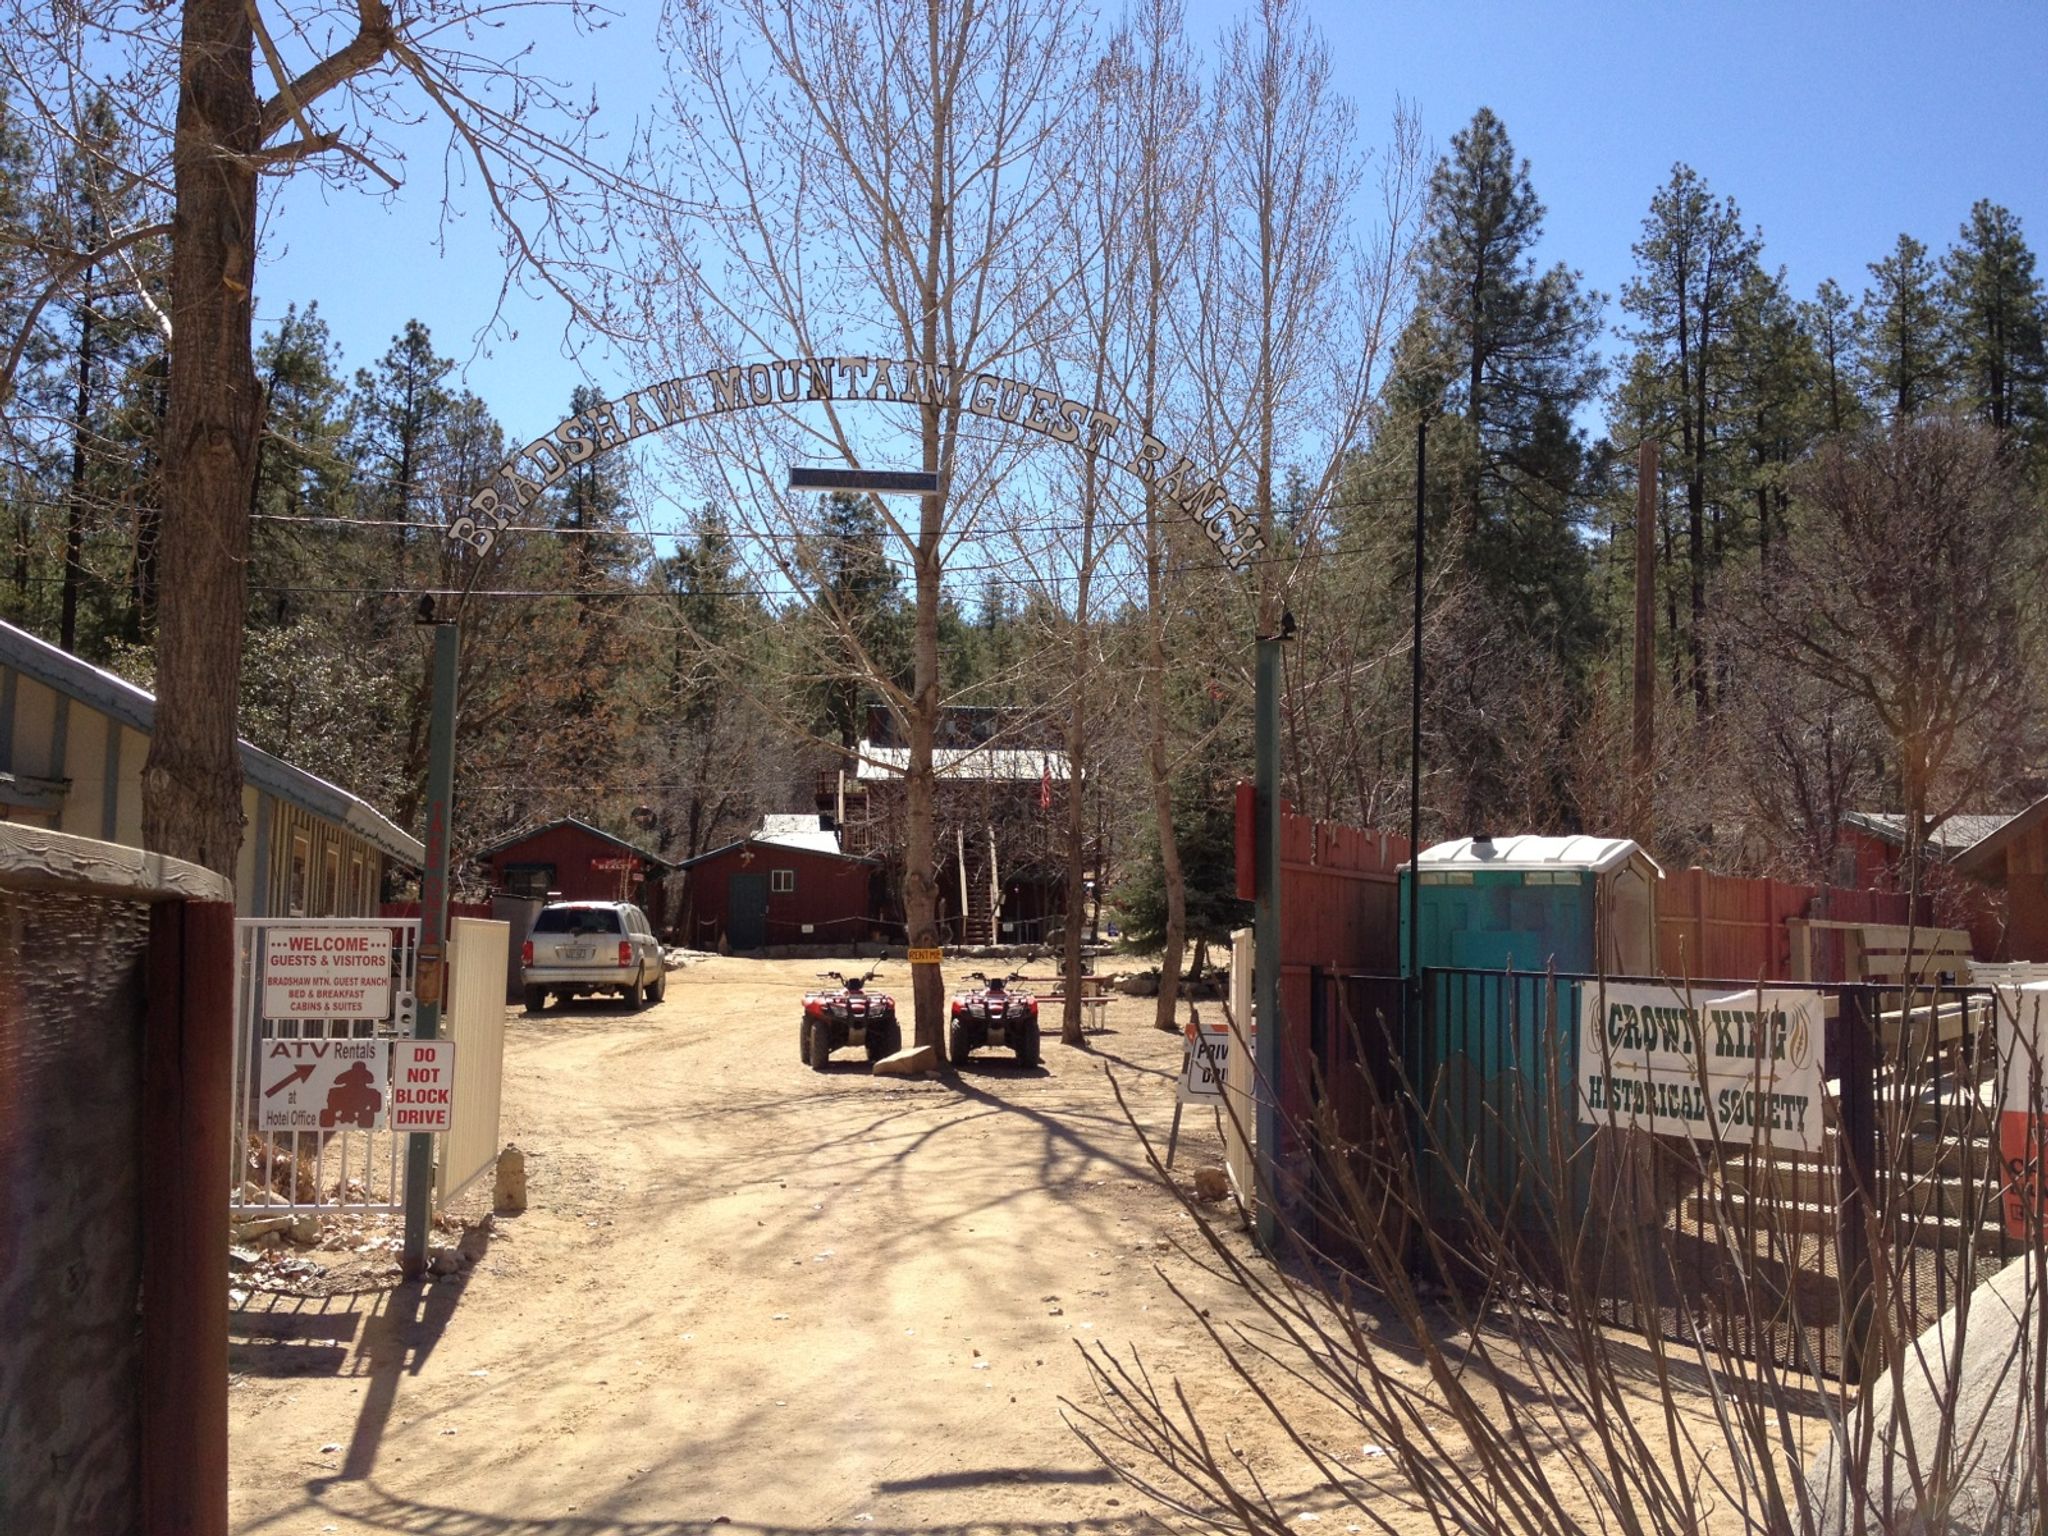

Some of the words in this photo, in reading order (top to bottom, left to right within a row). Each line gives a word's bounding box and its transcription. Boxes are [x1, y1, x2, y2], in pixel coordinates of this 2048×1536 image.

[447, 377, 686, 558] BRADSHAW
[707, 356, 951, 412] MOUNTAIN
[971, 374, 1120, 453] GUEST
[1126, 433, 1267, 570] RANCH
[289, 937, 369, 951] WELCOME
[271, 955, 317, 967] GUESTS
[321, 956, 329, 966] &
[333, 955, 386, 967] VISITORS
[267, 977, 310, 986] BRADSHAW
[312, 977, 331, 986] MTN.
[333, 977, 356, 987] GUEST
[361, 977, 388, 987] RANCH
[288, 990, 306, 999] BED
[308, 990, 314, 999] &
[316, 990, 365, 999] BREAKFAST
[290, 1002, 322, 1011] CABINS
[324, 1002, 330, 1011] &
[333, 1002, 363, 1011] SUITES
[1608, 1003, 1699, 1054] CROWN
[1711, 1010, 1787, 1060] KING
[270, 1042, 330, 1058] ATV
[334, 1042, 376, 1059] Rentals
[414, 1048, 436, 1062] DO
[407, 1068, 440, 1083] NOT
[288, 1090, 296, 1104] at
[395, 1089, 449, 1104] BLOCK
[1588, 1075, 1705, 1121] HISTORICAL
[1718, 1089, 1809, 1132] SOCIETY
[266, 1110, 289, 1125] Hotel
[291, 1110, 317, 1125] Office
[397, 1109, 446, 1124] DRIVE
